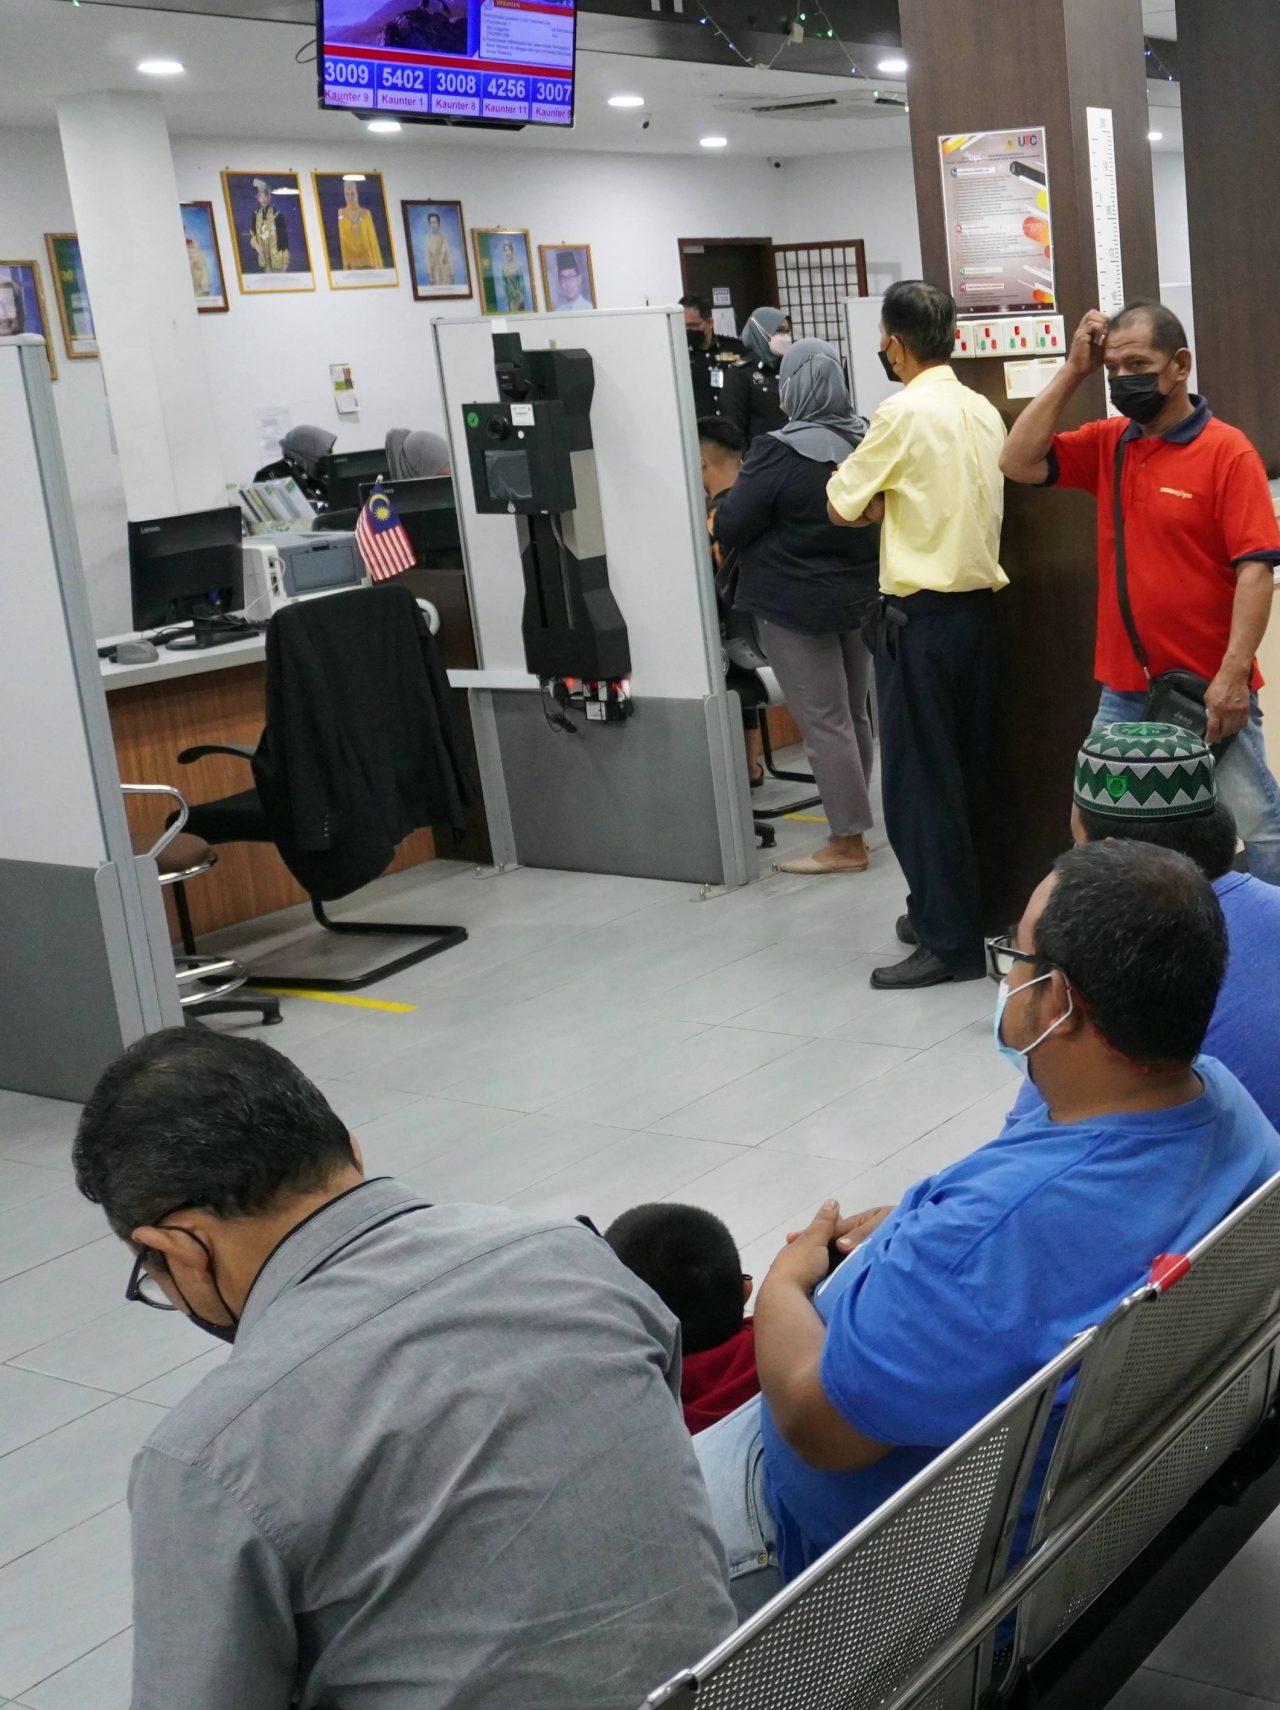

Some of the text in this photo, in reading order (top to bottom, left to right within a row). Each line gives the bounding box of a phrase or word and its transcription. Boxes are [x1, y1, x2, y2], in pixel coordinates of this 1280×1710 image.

[324, 61, 369, 84] 3009
[382, 67, 424, 89] 5402
[436, 72, 476, 94] 3008
[487, 78, 526, 98] 4256
[324, 89, 369, 102] Kaunter 9
[536, 82, 572, 102] 3007
[381, 94, 417, 106] Kaunter
[436, 98, 476, 111] Kaunter 8
[484, 103, 527, 115] Kaunter 11
[535, 107, 566, 118] Kaunter
[1017, 132, 1038, 147] UTC
